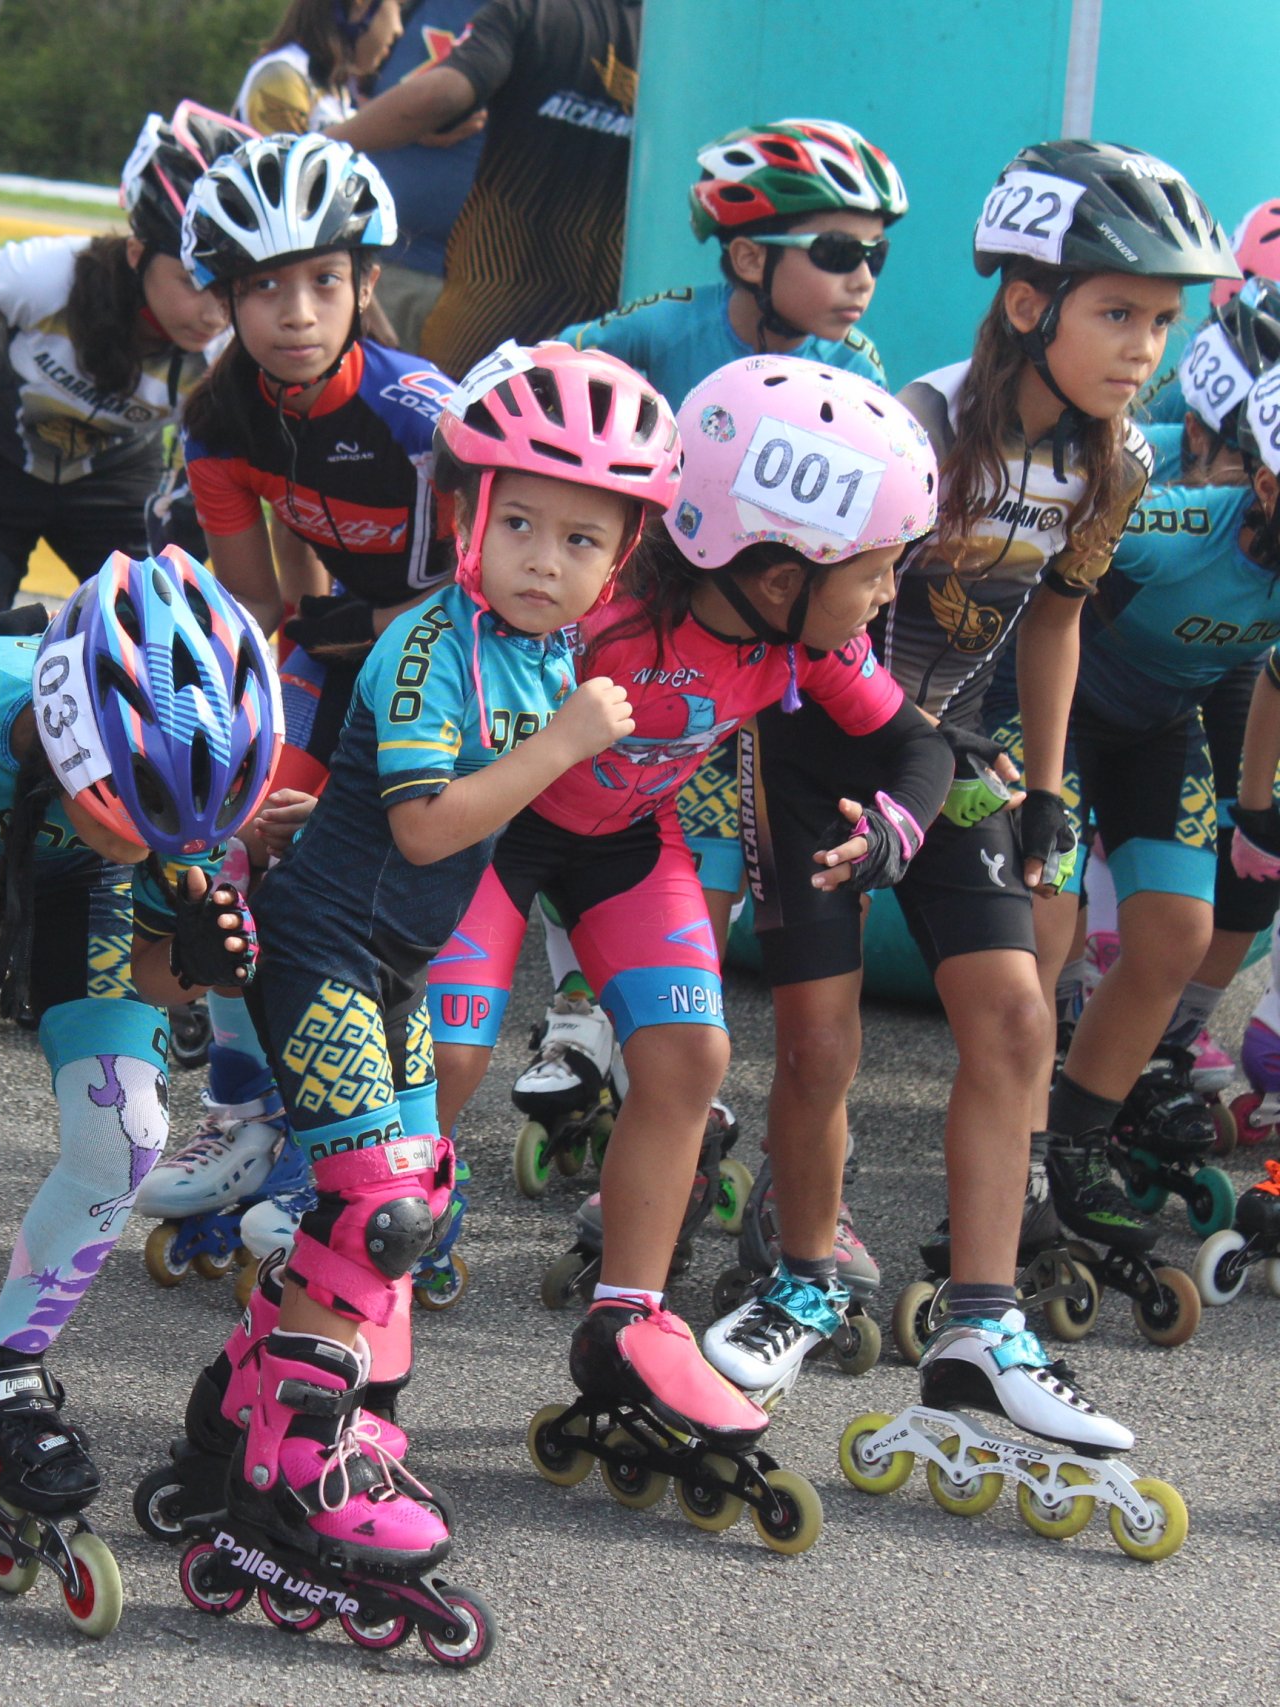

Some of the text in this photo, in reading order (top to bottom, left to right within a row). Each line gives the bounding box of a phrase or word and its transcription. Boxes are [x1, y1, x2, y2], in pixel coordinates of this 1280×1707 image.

[984, 186, 1062, 240] 022
[1188, 340, 1236, 410] 039
[753, 437, 864, 518] 001
[39, 654, 92, 774] 031
[740, 730, 766, 902] ALCARAVAN
[440, 994, 490, 1030] UP
[872, 1429, 909, 1451] FLYKE
[980, 1440, 1044, 1461] NITRO
[1105, 1479, 1140, 1516] FLYKE
